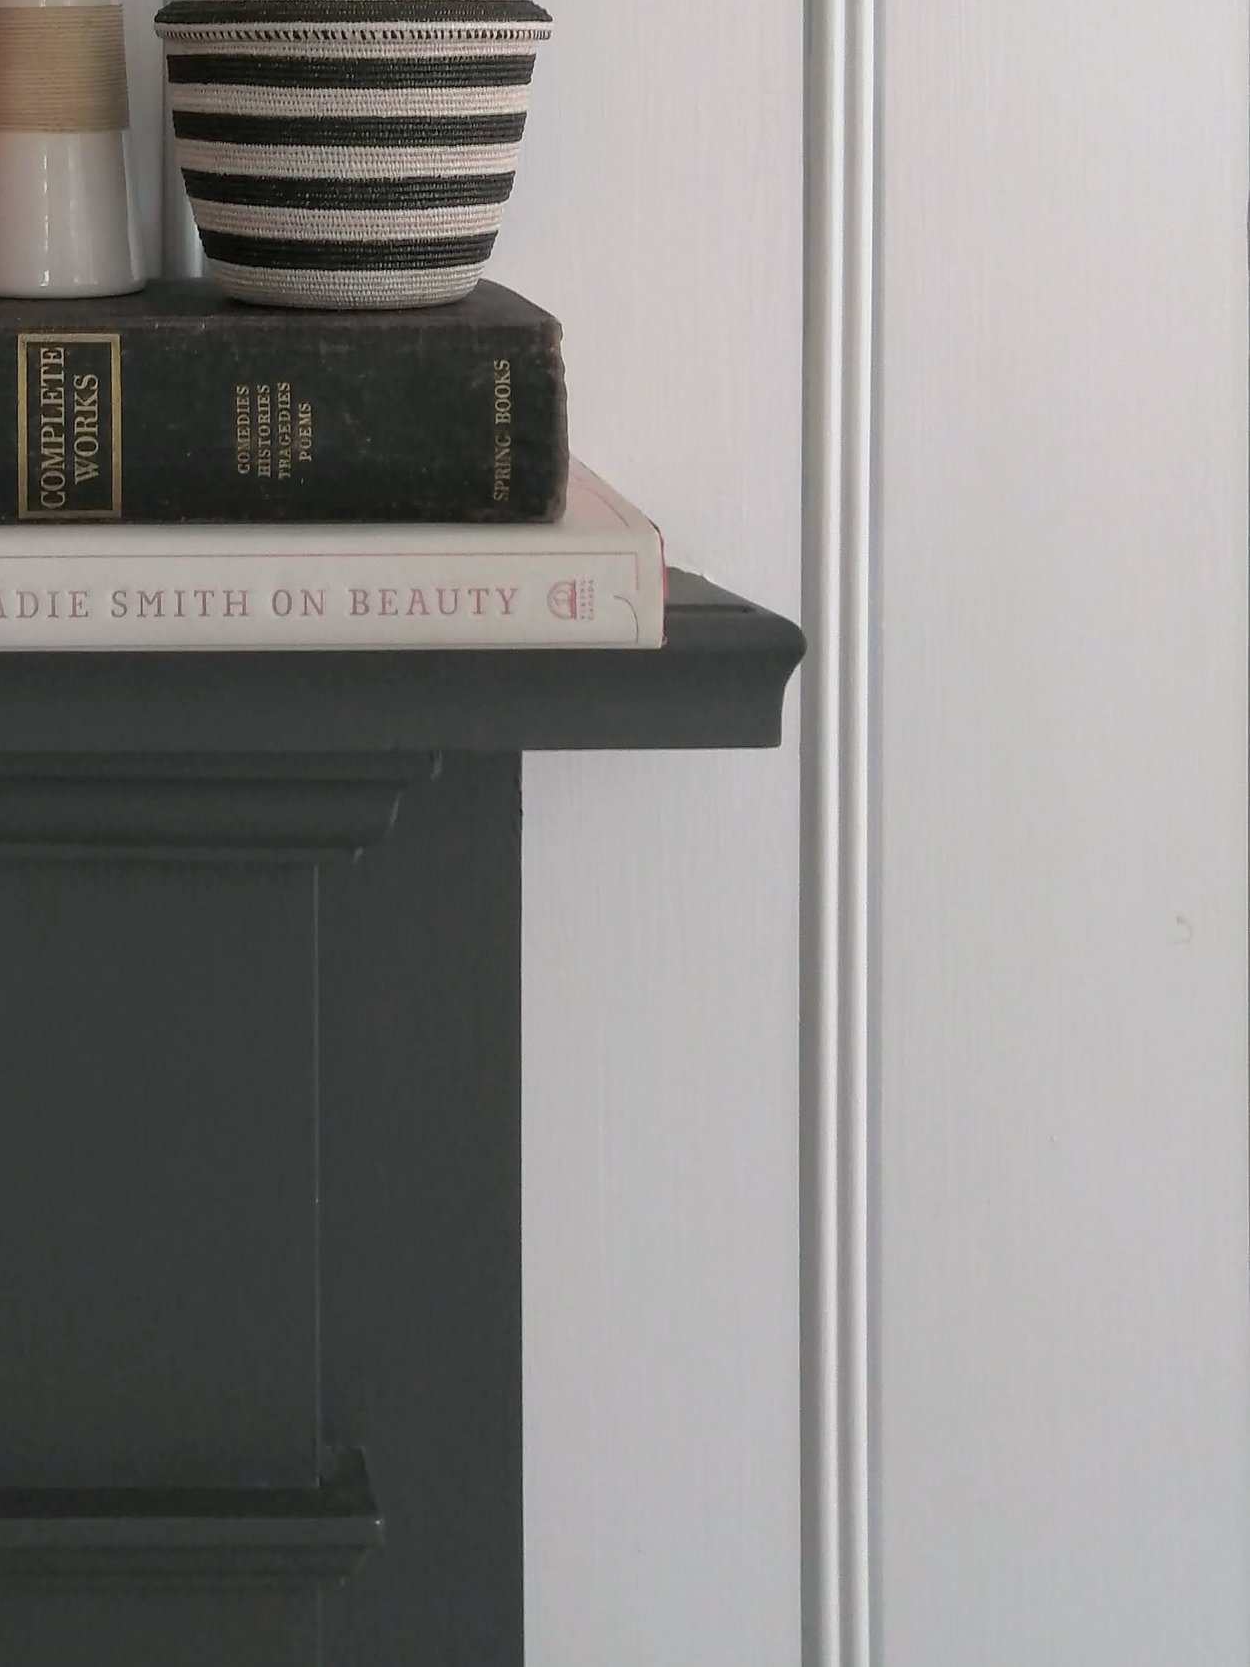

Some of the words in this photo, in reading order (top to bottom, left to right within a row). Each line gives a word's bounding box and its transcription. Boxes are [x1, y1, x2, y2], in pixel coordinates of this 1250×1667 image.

[40, 347, 66, 508] COMPLETE
[73, 373, 100, 484] WORKS
[236, 385, 251, 475] COMEDIES
[256, 384, 271, 478] HISTORIES
[277, 382, 291, 480] TRAGEDIES
[298, 402, 312, 462] POEMS
[493, 358, 511, 425] BOOKS
[110, 588, 250, 618] SMITH
[271, 588, 332, 617] ON
[349, 586, 521, 616] BEAUTY
